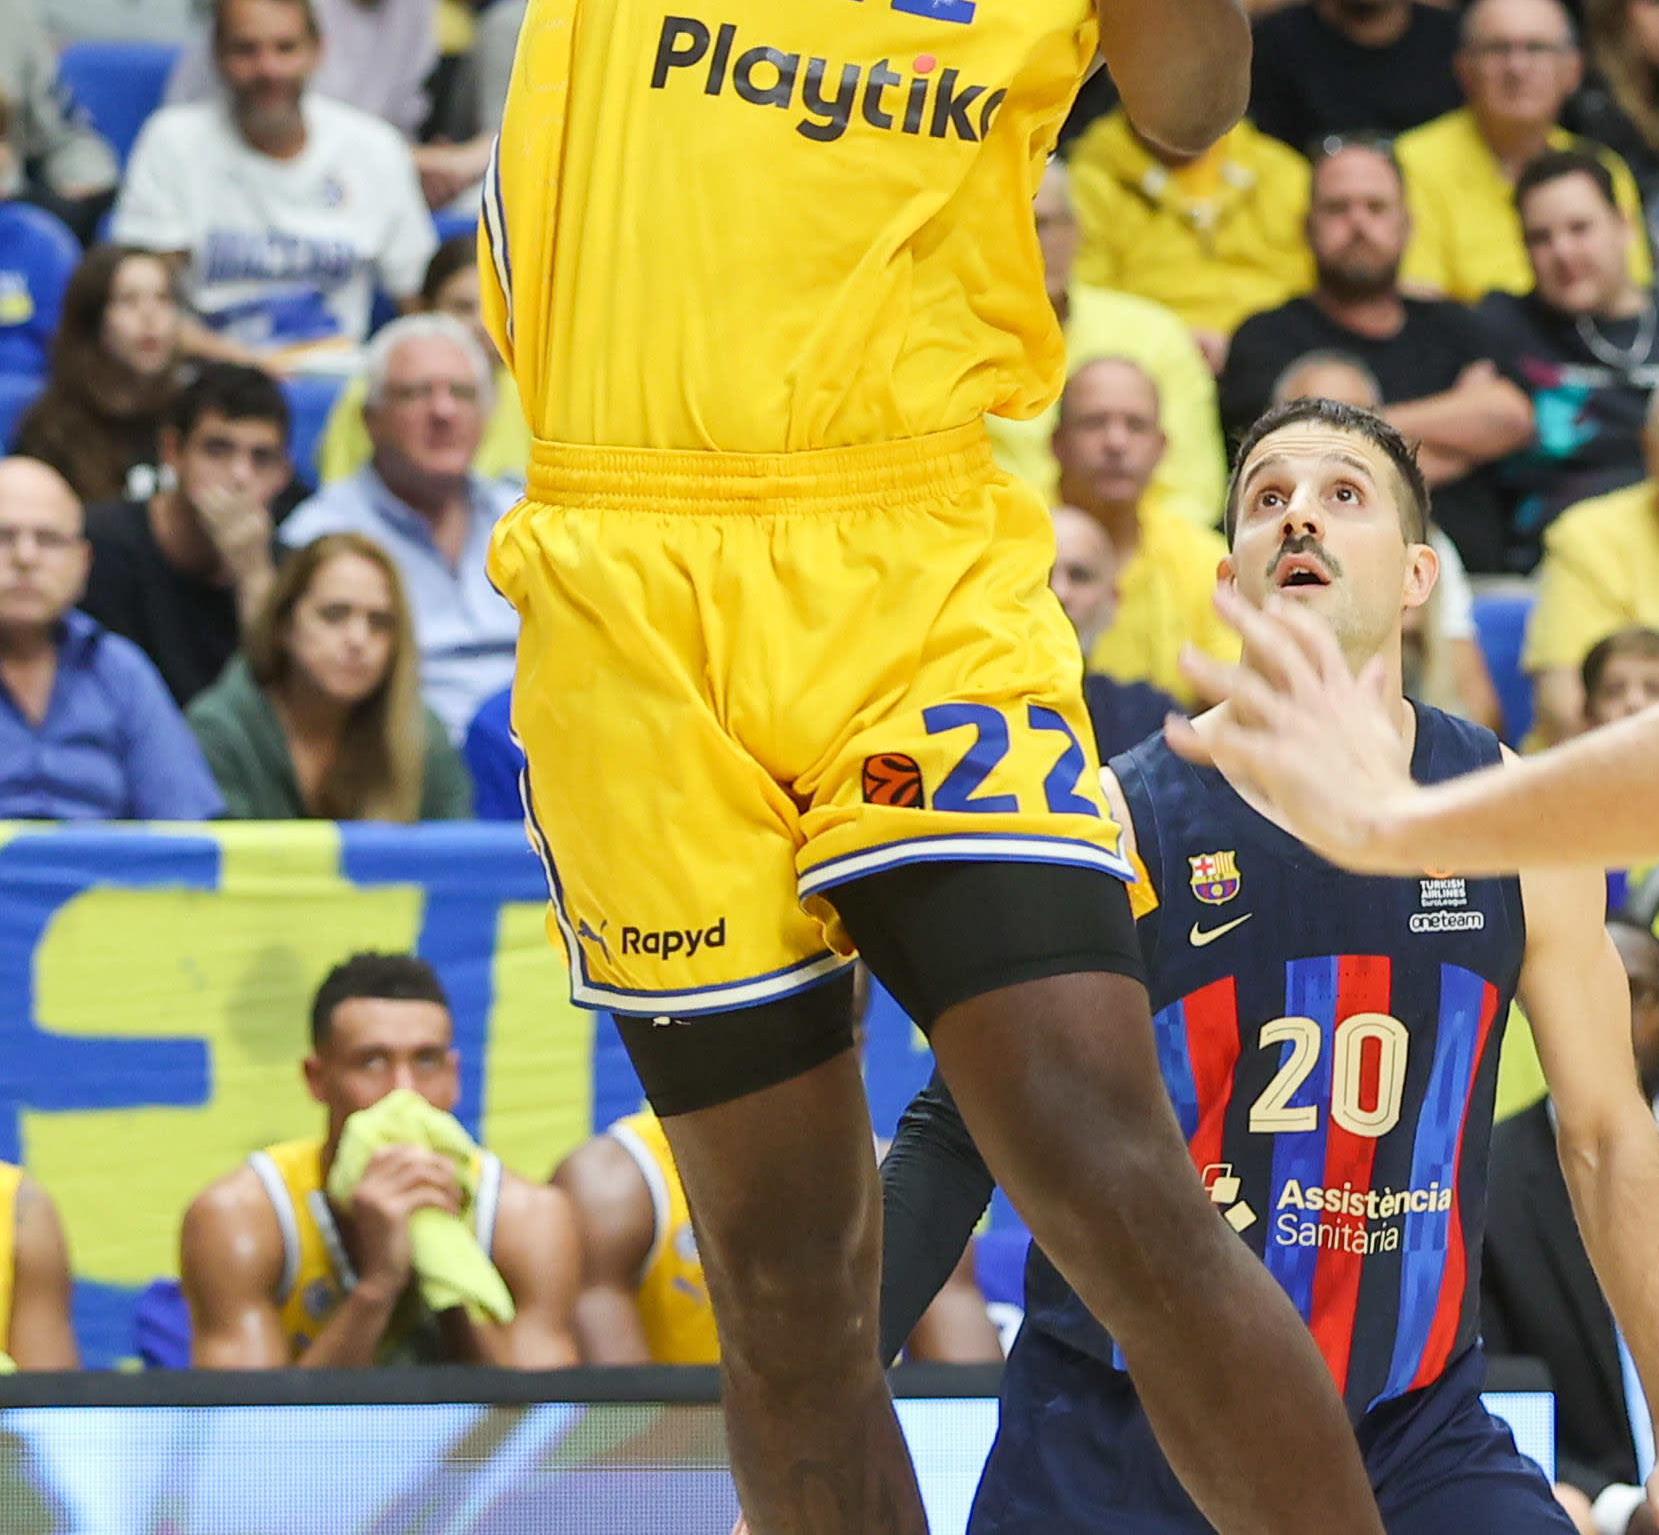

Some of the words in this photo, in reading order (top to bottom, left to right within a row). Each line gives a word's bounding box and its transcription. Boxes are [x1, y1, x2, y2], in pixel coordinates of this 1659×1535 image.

[922, 703, 1103, 817] 22
[1420, 878, 1465, 890] TURKISH
[1421, 888, 1467, 899] AIRLINES
[622, 917, 726, 961] Rapyd
[1411, 913, 1482, 930] oneteam
[1249, 1012, 1410, 1138] 20
[1276, 1178, 1453, 1220] Assistència
[1275, 1212, 1400, 1256] Sanitària
